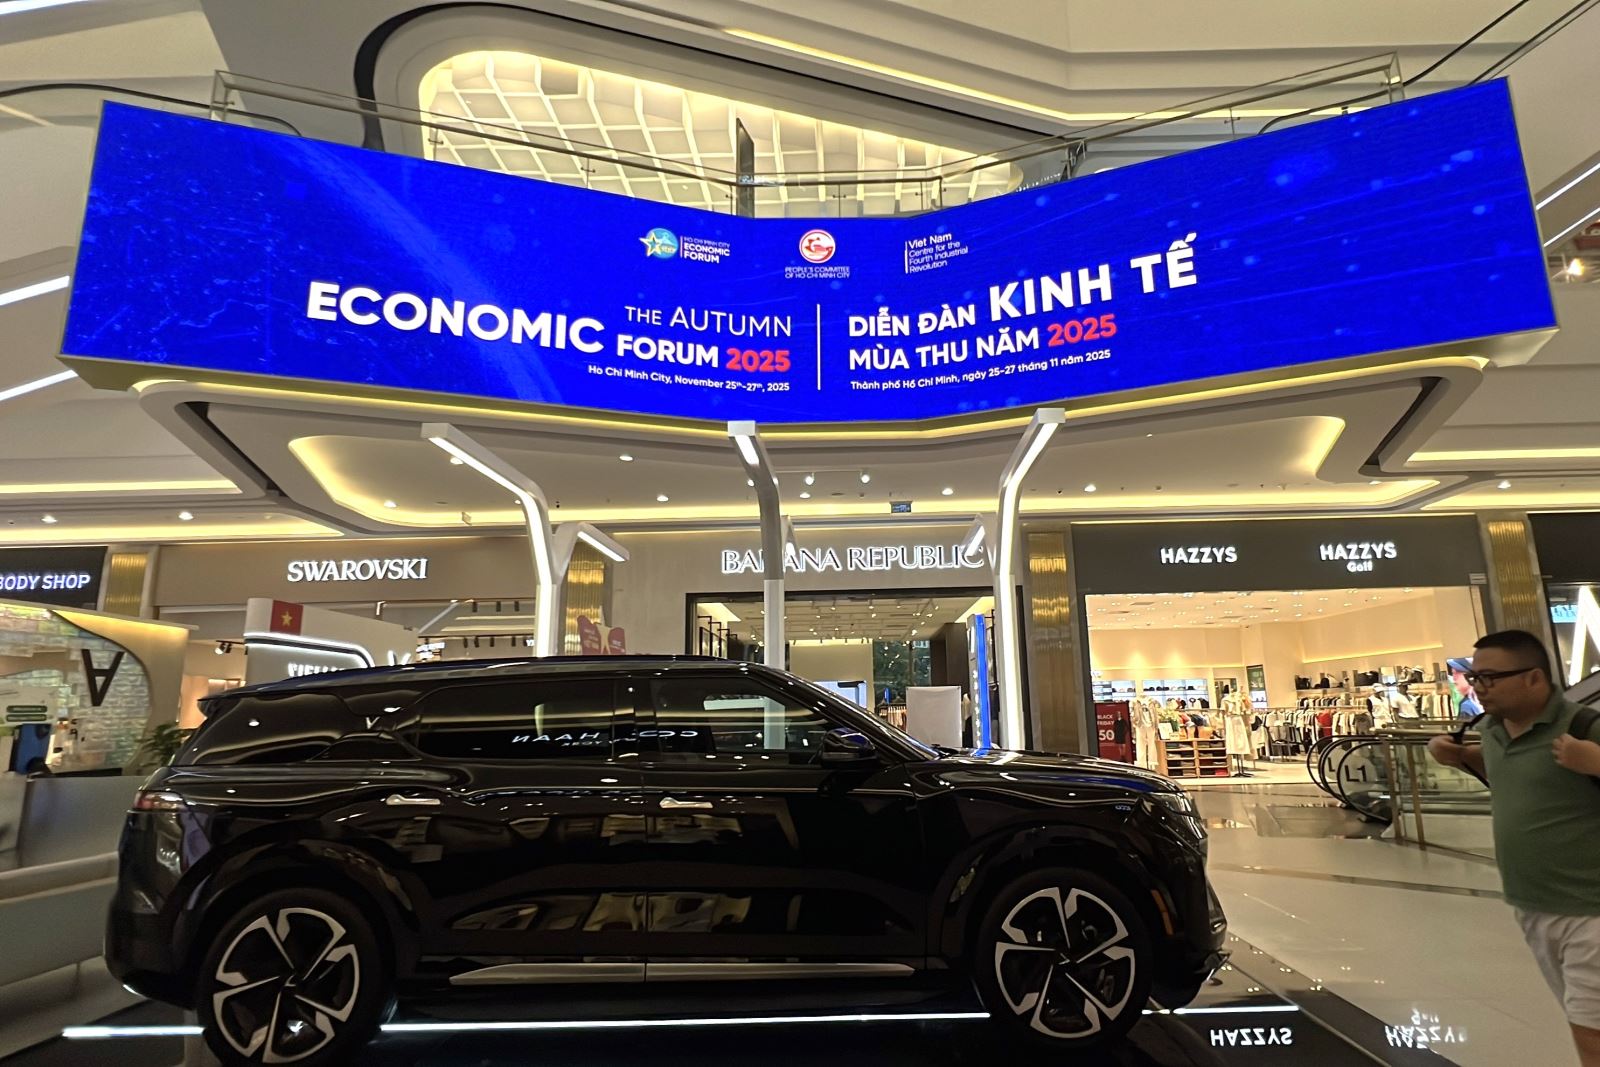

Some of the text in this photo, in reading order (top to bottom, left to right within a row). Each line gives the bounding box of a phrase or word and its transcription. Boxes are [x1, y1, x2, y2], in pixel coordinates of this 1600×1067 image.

[683, 242, 731, 257] ECONOMIC
[908, 233, 952, 249] Viet Nam
[908, 241, 961, 258] Centre for the
[683, 250, 720, 264] FORUM
[909, 245, 969, 266] Fourth Industrial
[909, 260, 948, 274] Revolution
[848, 232, 1198, 337] DIỄN ĐÀN KINH TẾ
[306, 280, 792, 372] ECONOMIC FORUM 2025
[624, 305, 792, 338] THE AUTUMN
[849, 313, 1118, 370] MÙA THU NĂM 2025
[588, 364, 604, 375] Ho
[604, 366, 623, 377] Chi
[624, 368, 649, 381] Minh
[650, 372, 673, 385] City,
[674, 374, 724, 389] November
[766, 382, 791, 392] 2025
[850, 380, 881, 391] Thành
[917, 377, 934, 388] Chi
[935, 374, 961, 386] Minh,
[962, 370, 987, 382] ngày
[1017, 360, 1048, 374] tháng
[1049, 358, 1059, 367] 11
[1060, 355, 1084, 366] năm
[1085, 349, 1112, 362] 2025
[847, 544, 985, 573] REPUBLIC
[1160, 547, 1238, 564] HAZZYS
[1319, 542, 1397, 561] HAZZYS
[287, 558, 428, 582] SWAROVSKI
[1346, 561, 1374, 573] Golf
[41, 574, 91, 590] SHOP
[1098, 729, 1115, 741] 50
[1344, 764, 1367, 783] L1
